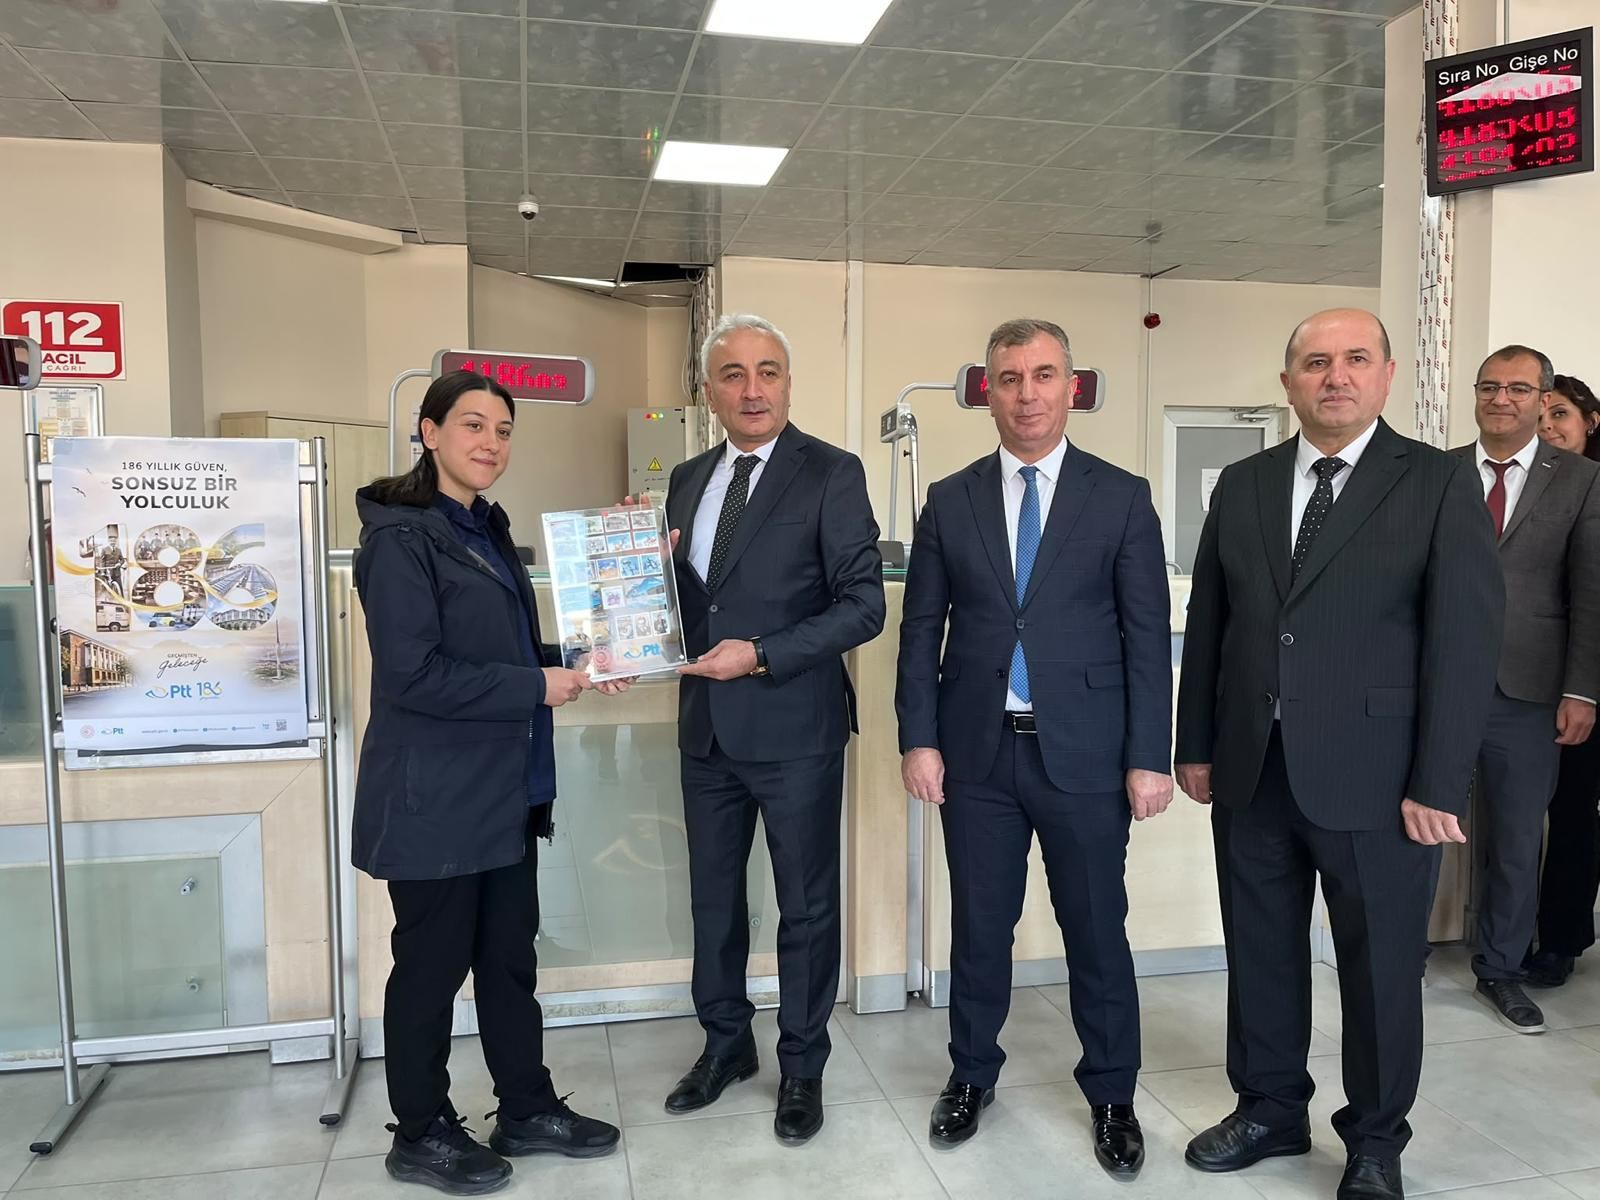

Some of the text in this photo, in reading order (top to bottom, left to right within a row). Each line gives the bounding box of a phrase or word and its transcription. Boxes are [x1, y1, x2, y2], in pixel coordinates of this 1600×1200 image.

[1438, 48, 1578, 86] Sıra No Gişe No
[21, 311, 103, 346] 112
[42, 353, 86, 364] ACİL
[122, 461, 228, 473] 186 YILLIK GÜVEN,
[112, 474, 238, 492] SONSUZ BİR
[120, 495, 230, 509] YOLCULUK
[170, 685, 192, 698] Ptt
[112, 727, 124, 735] Ptt
